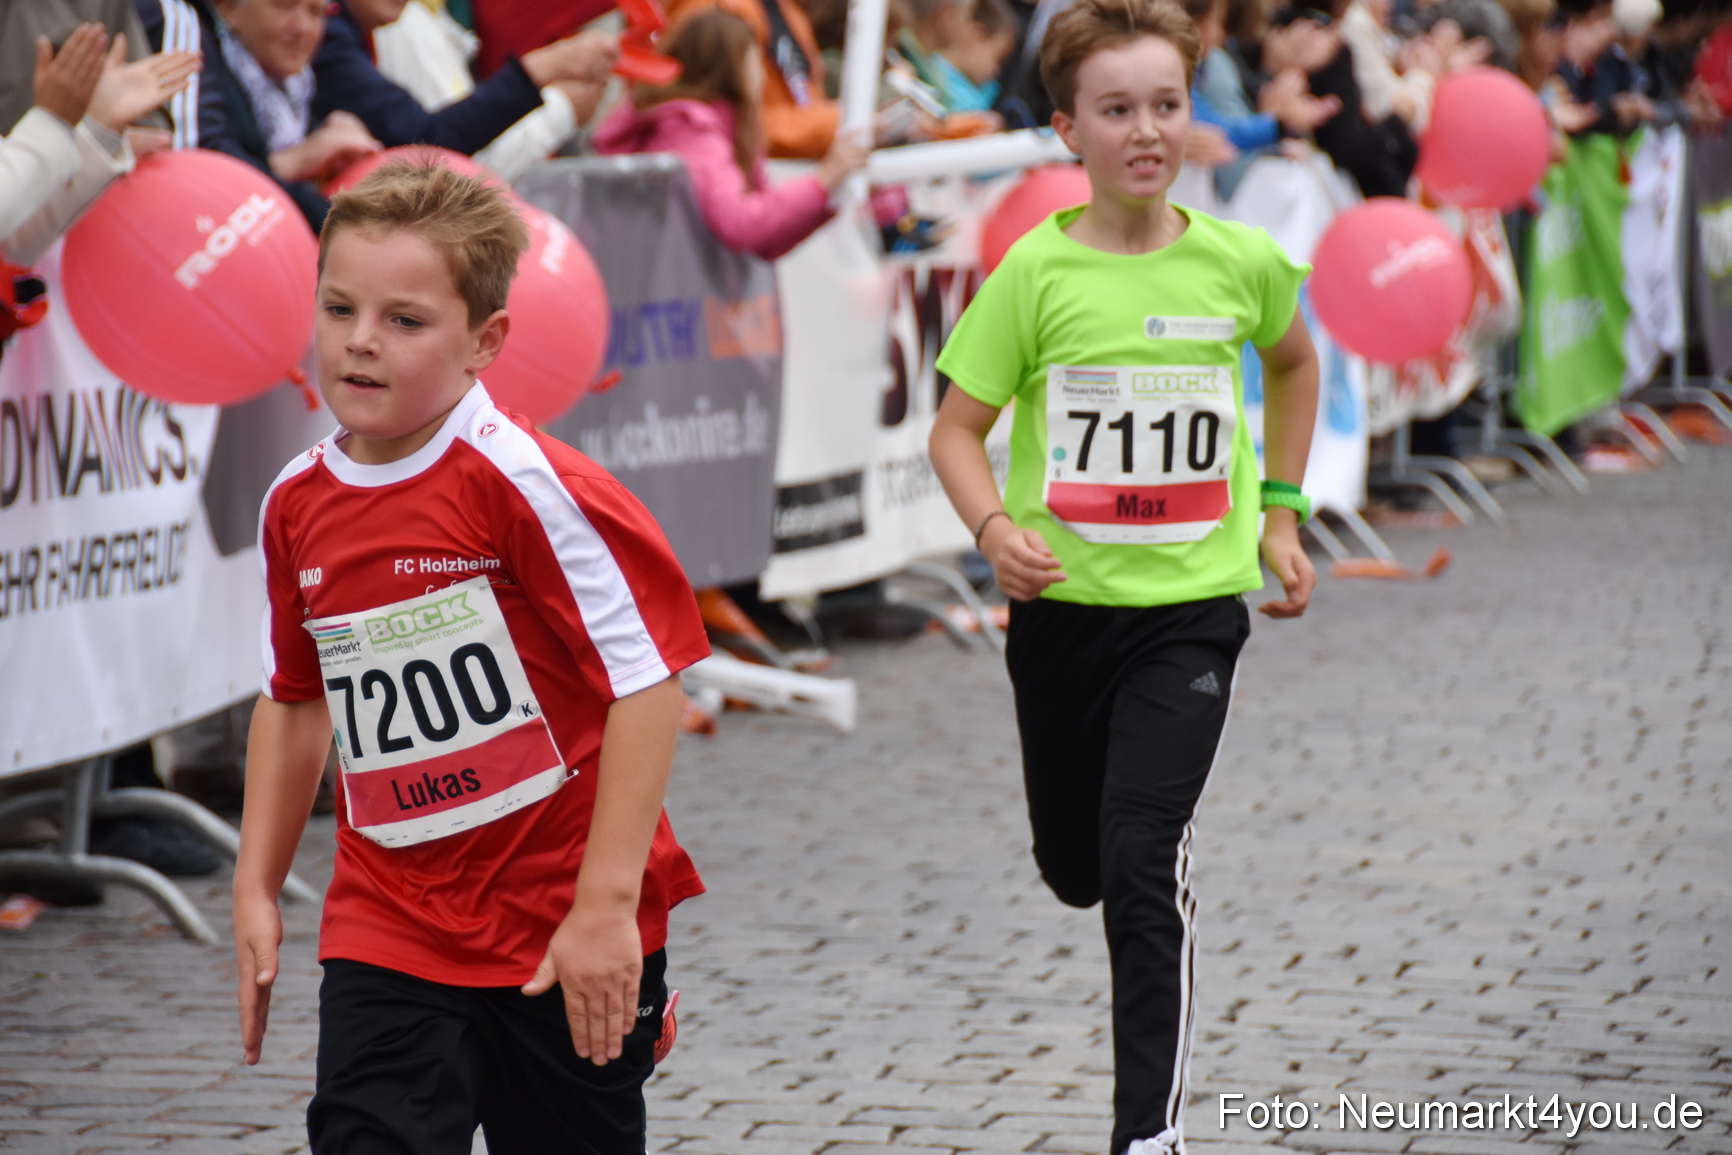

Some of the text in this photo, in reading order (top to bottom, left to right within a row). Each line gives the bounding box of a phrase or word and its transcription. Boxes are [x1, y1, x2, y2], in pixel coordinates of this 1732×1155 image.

[1063, 373, 1221, 396] NeuerMarkt BOCK
[1067, 411, 1220, 473] 7110
[1116, 494, 1166, 518] Max
[395, 556, 501, 575] FC Holzheim
[317, 590, 479, 659] euerMarkt BOCK
[403, 641, 414, 650] by
[415, 630, 441, 646] smart
[442, 617, 485, 638] concepts
[325, 642, 512, 759] 7200
[521, 702, 534, 717] K
[391, 767, 482, 811] Lukas
